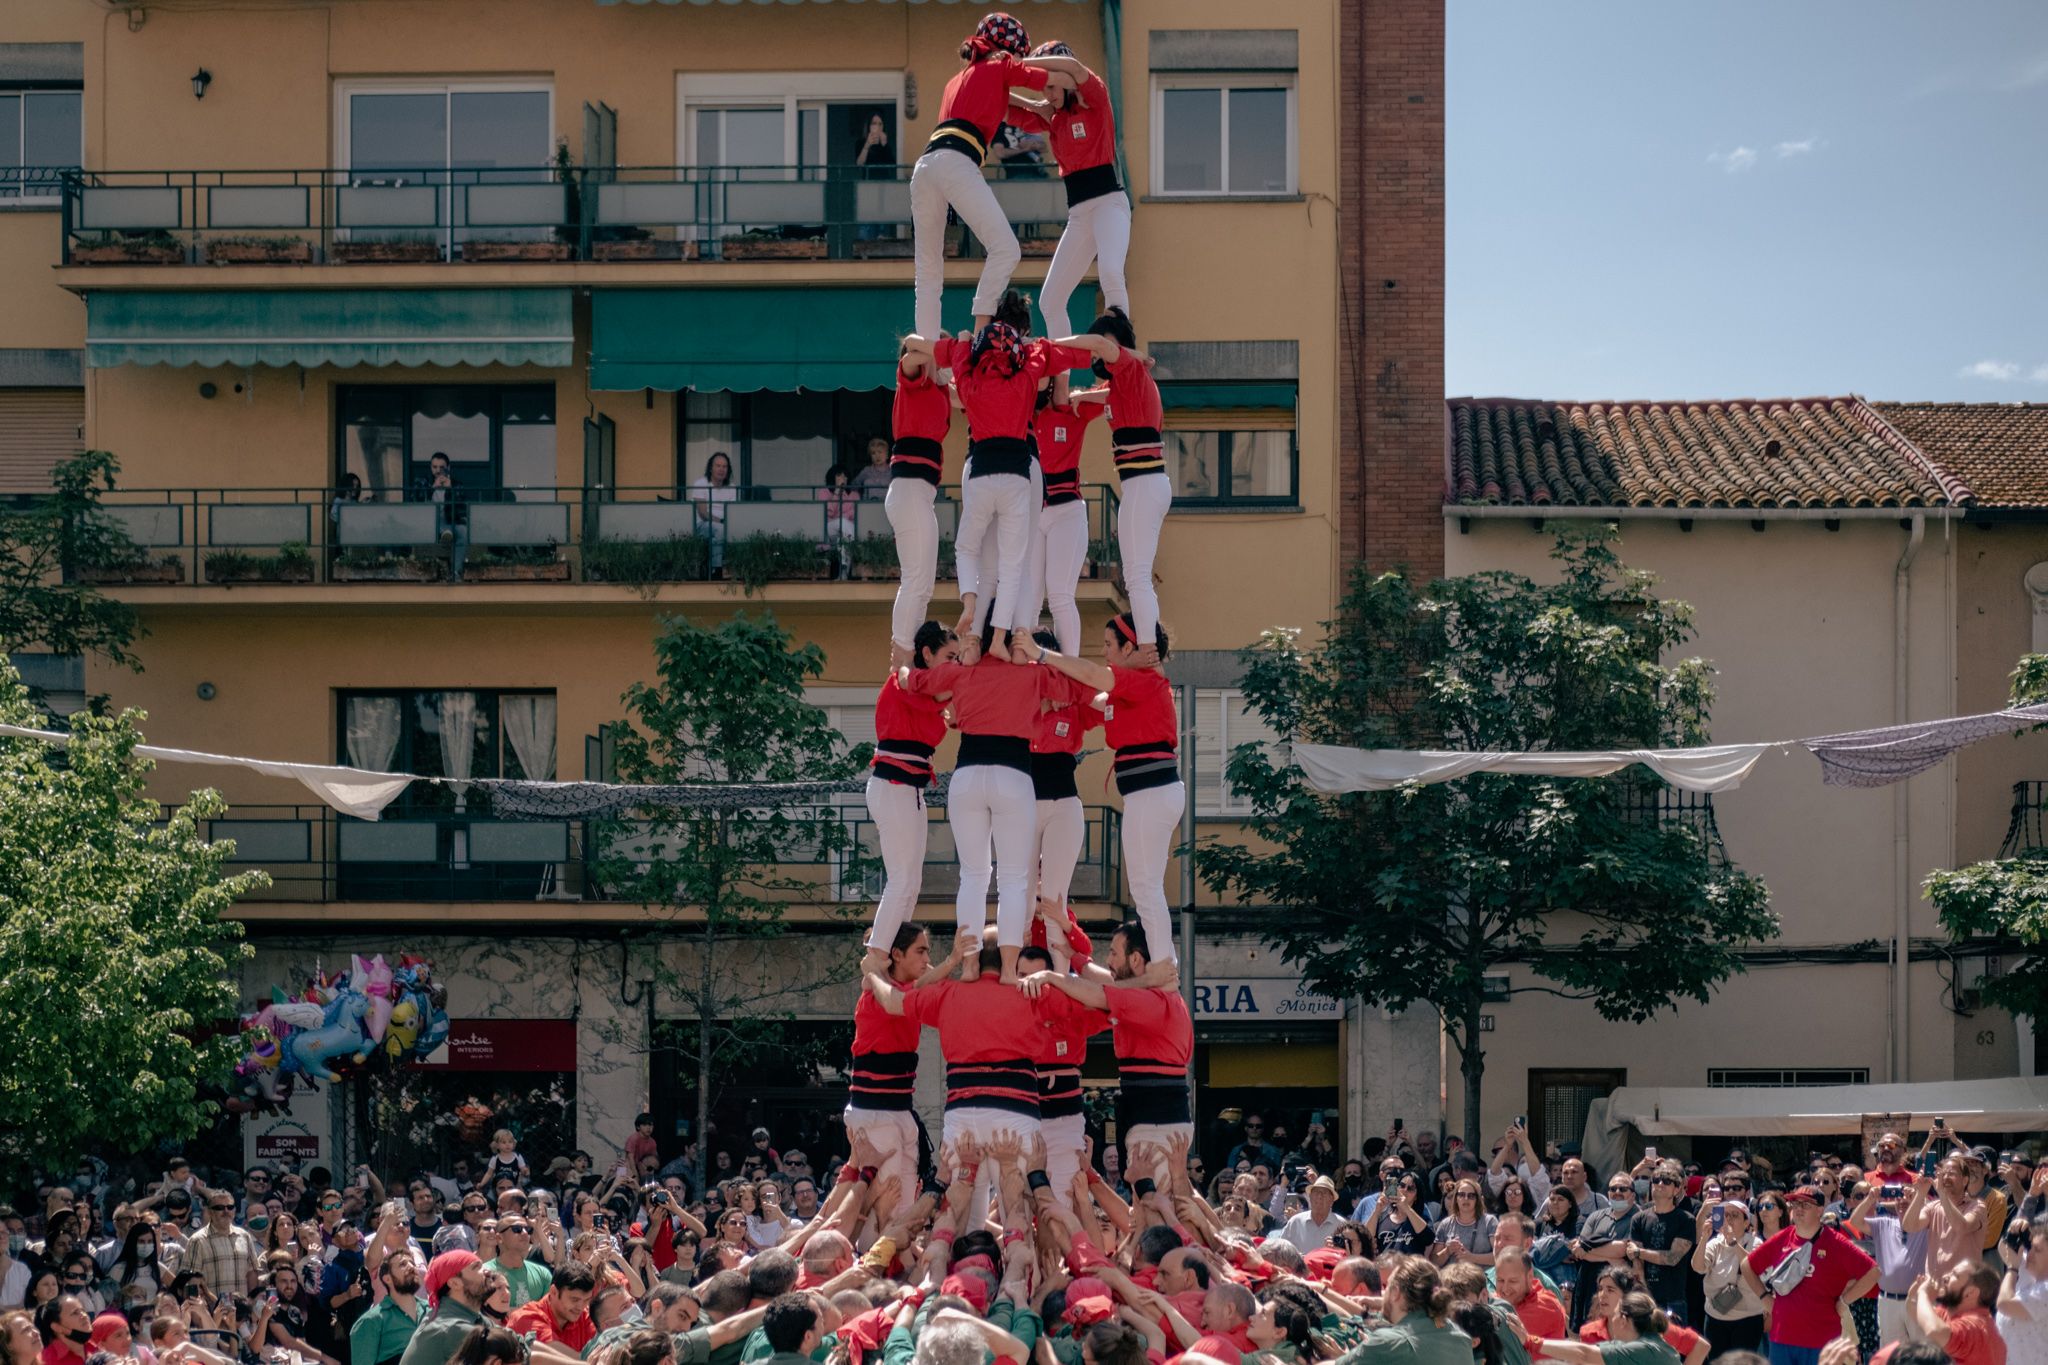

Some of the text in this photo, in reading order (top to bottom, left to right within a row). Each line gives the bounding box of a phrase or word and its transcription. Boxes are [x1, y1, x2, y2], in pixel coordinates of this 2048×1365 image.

[1275, 1000, 1337, 1015] Mònica
[1976, 1030, 1995, 1046] 63
[275, 1138, 297, 1147] SOM
[258, 1148, 317, 1157] FABRANTS
